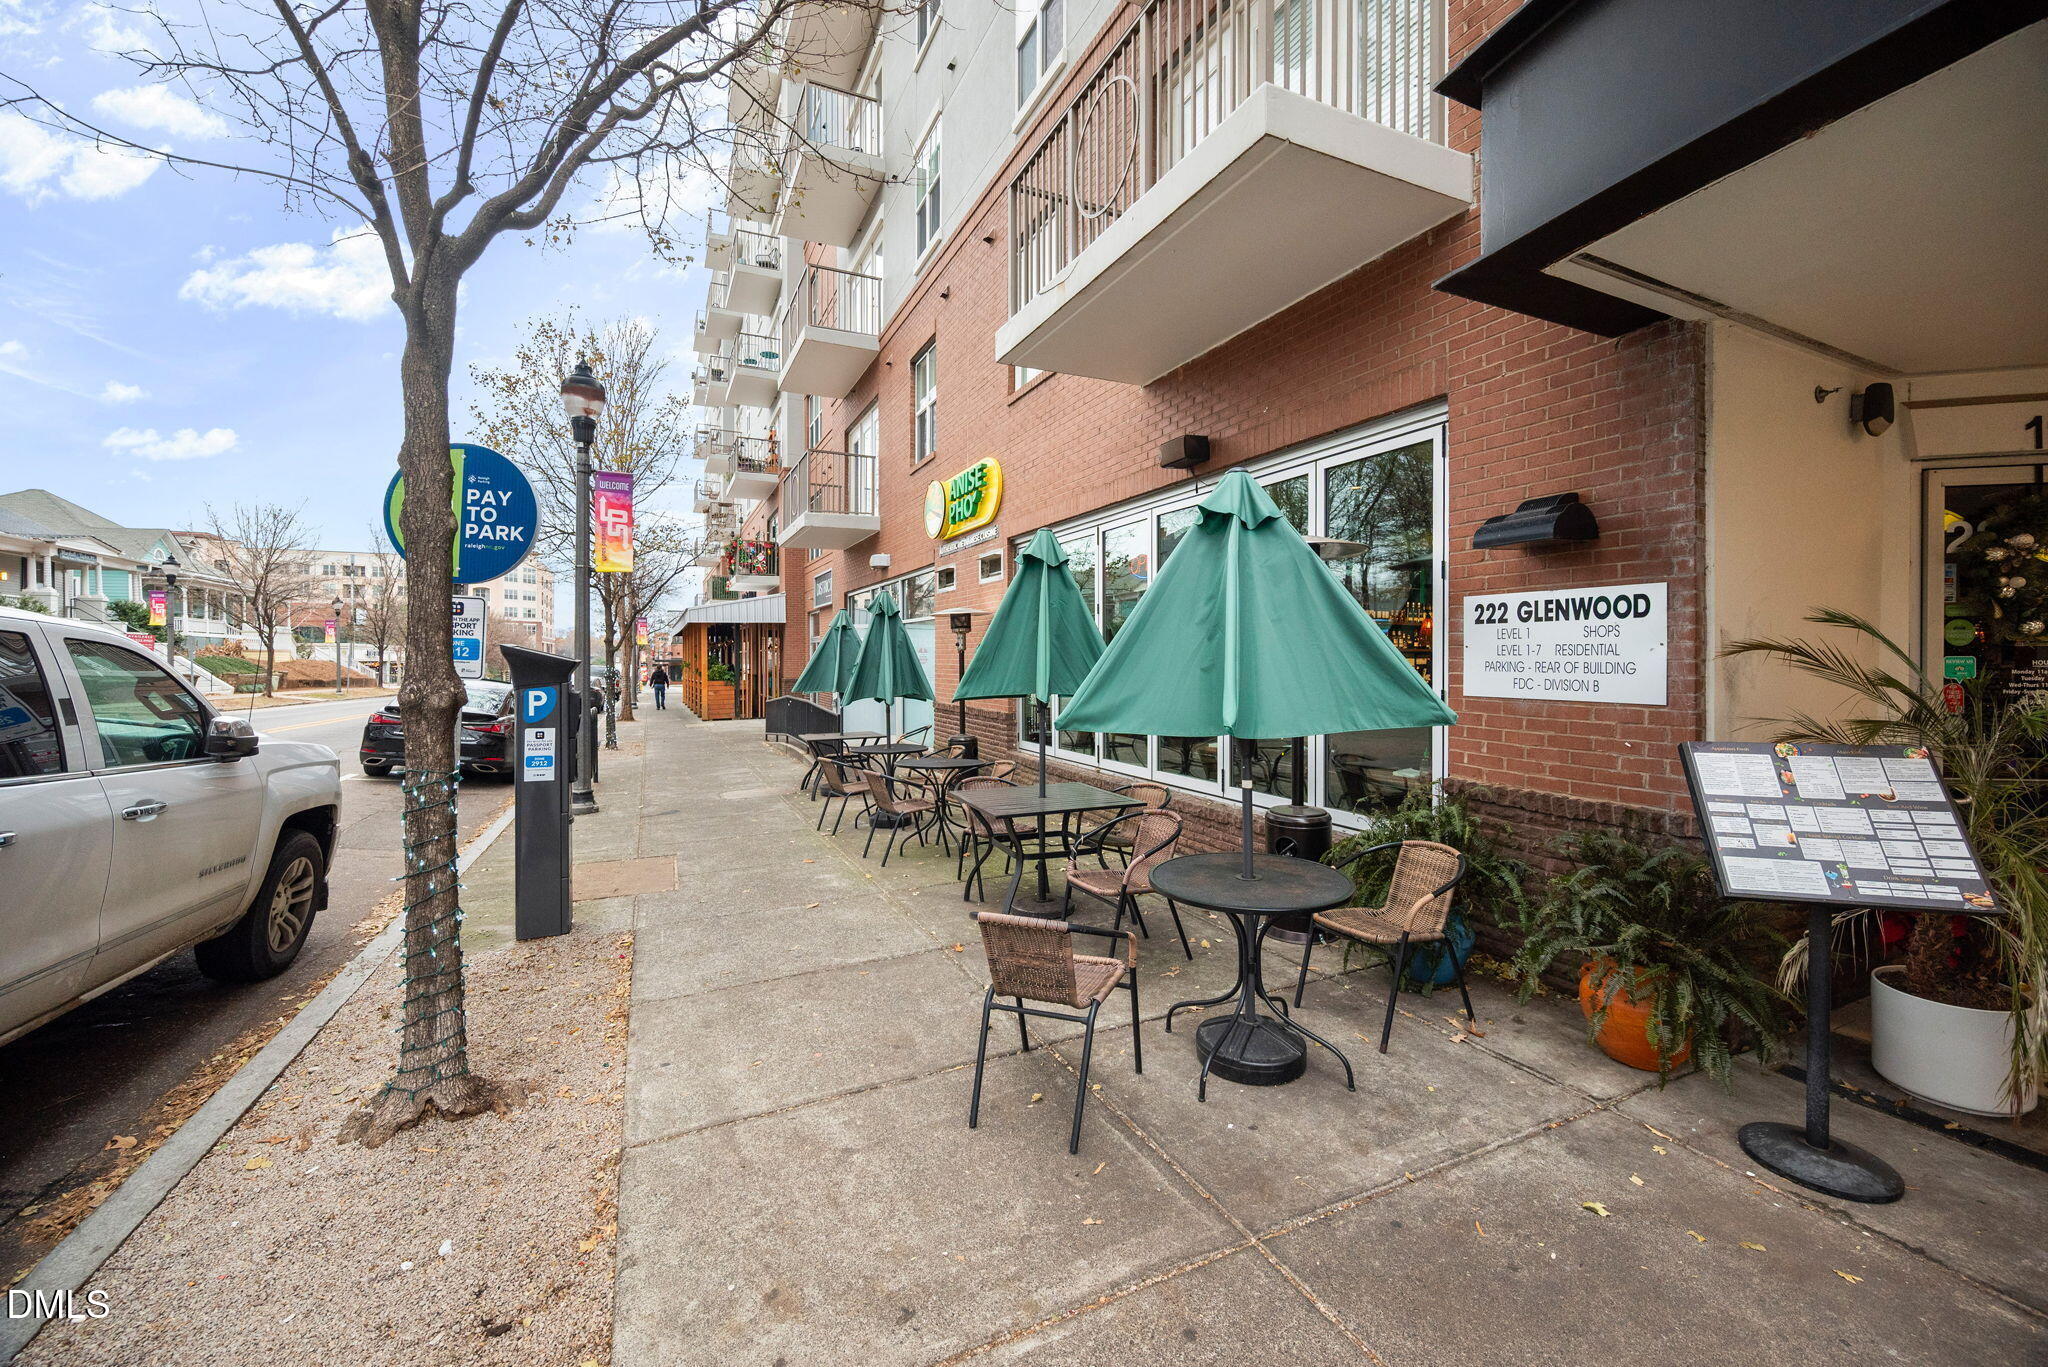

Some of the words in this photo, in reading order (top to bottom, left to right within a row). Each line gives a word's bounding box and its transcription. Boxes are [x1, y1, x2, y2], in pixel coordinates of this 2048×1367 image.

[599, 480, 630, 492] WELCOME
[950, 463, 987, 501] ANISE
[466, 488, 513, 507] PAY
[466, 505, 498, 523] TO
[465, 523, 525, 542] PARK
[1474, 601, 1509, 625] 222
[1517, 593, 1651, 623] GLENWOOD
[1496, 627, 1522, 640] LEVEL
[1526, 627, 1531, 639] 1
[1583, 624, 1621, 638] SHOPS
[1496, 644, 1523, 656] LEVEL
[1526, 644, 1542, 656] 1-7
[1555, 643, 1621, 656] RESIDENTIAL
[1484, 661, 1525, 673] PARKING
[1534, 661, 1560, 674] REAR
[1564, 661, 1579, 674] OF
[1583, 661, 1637, 675] BUILDING
[1513, 678, 1534, 690] FDC
[1544, 678, 1590, 692] DIVISION
[1593, 680, 1600, 692] B
[528, 690, 548, 717] P
